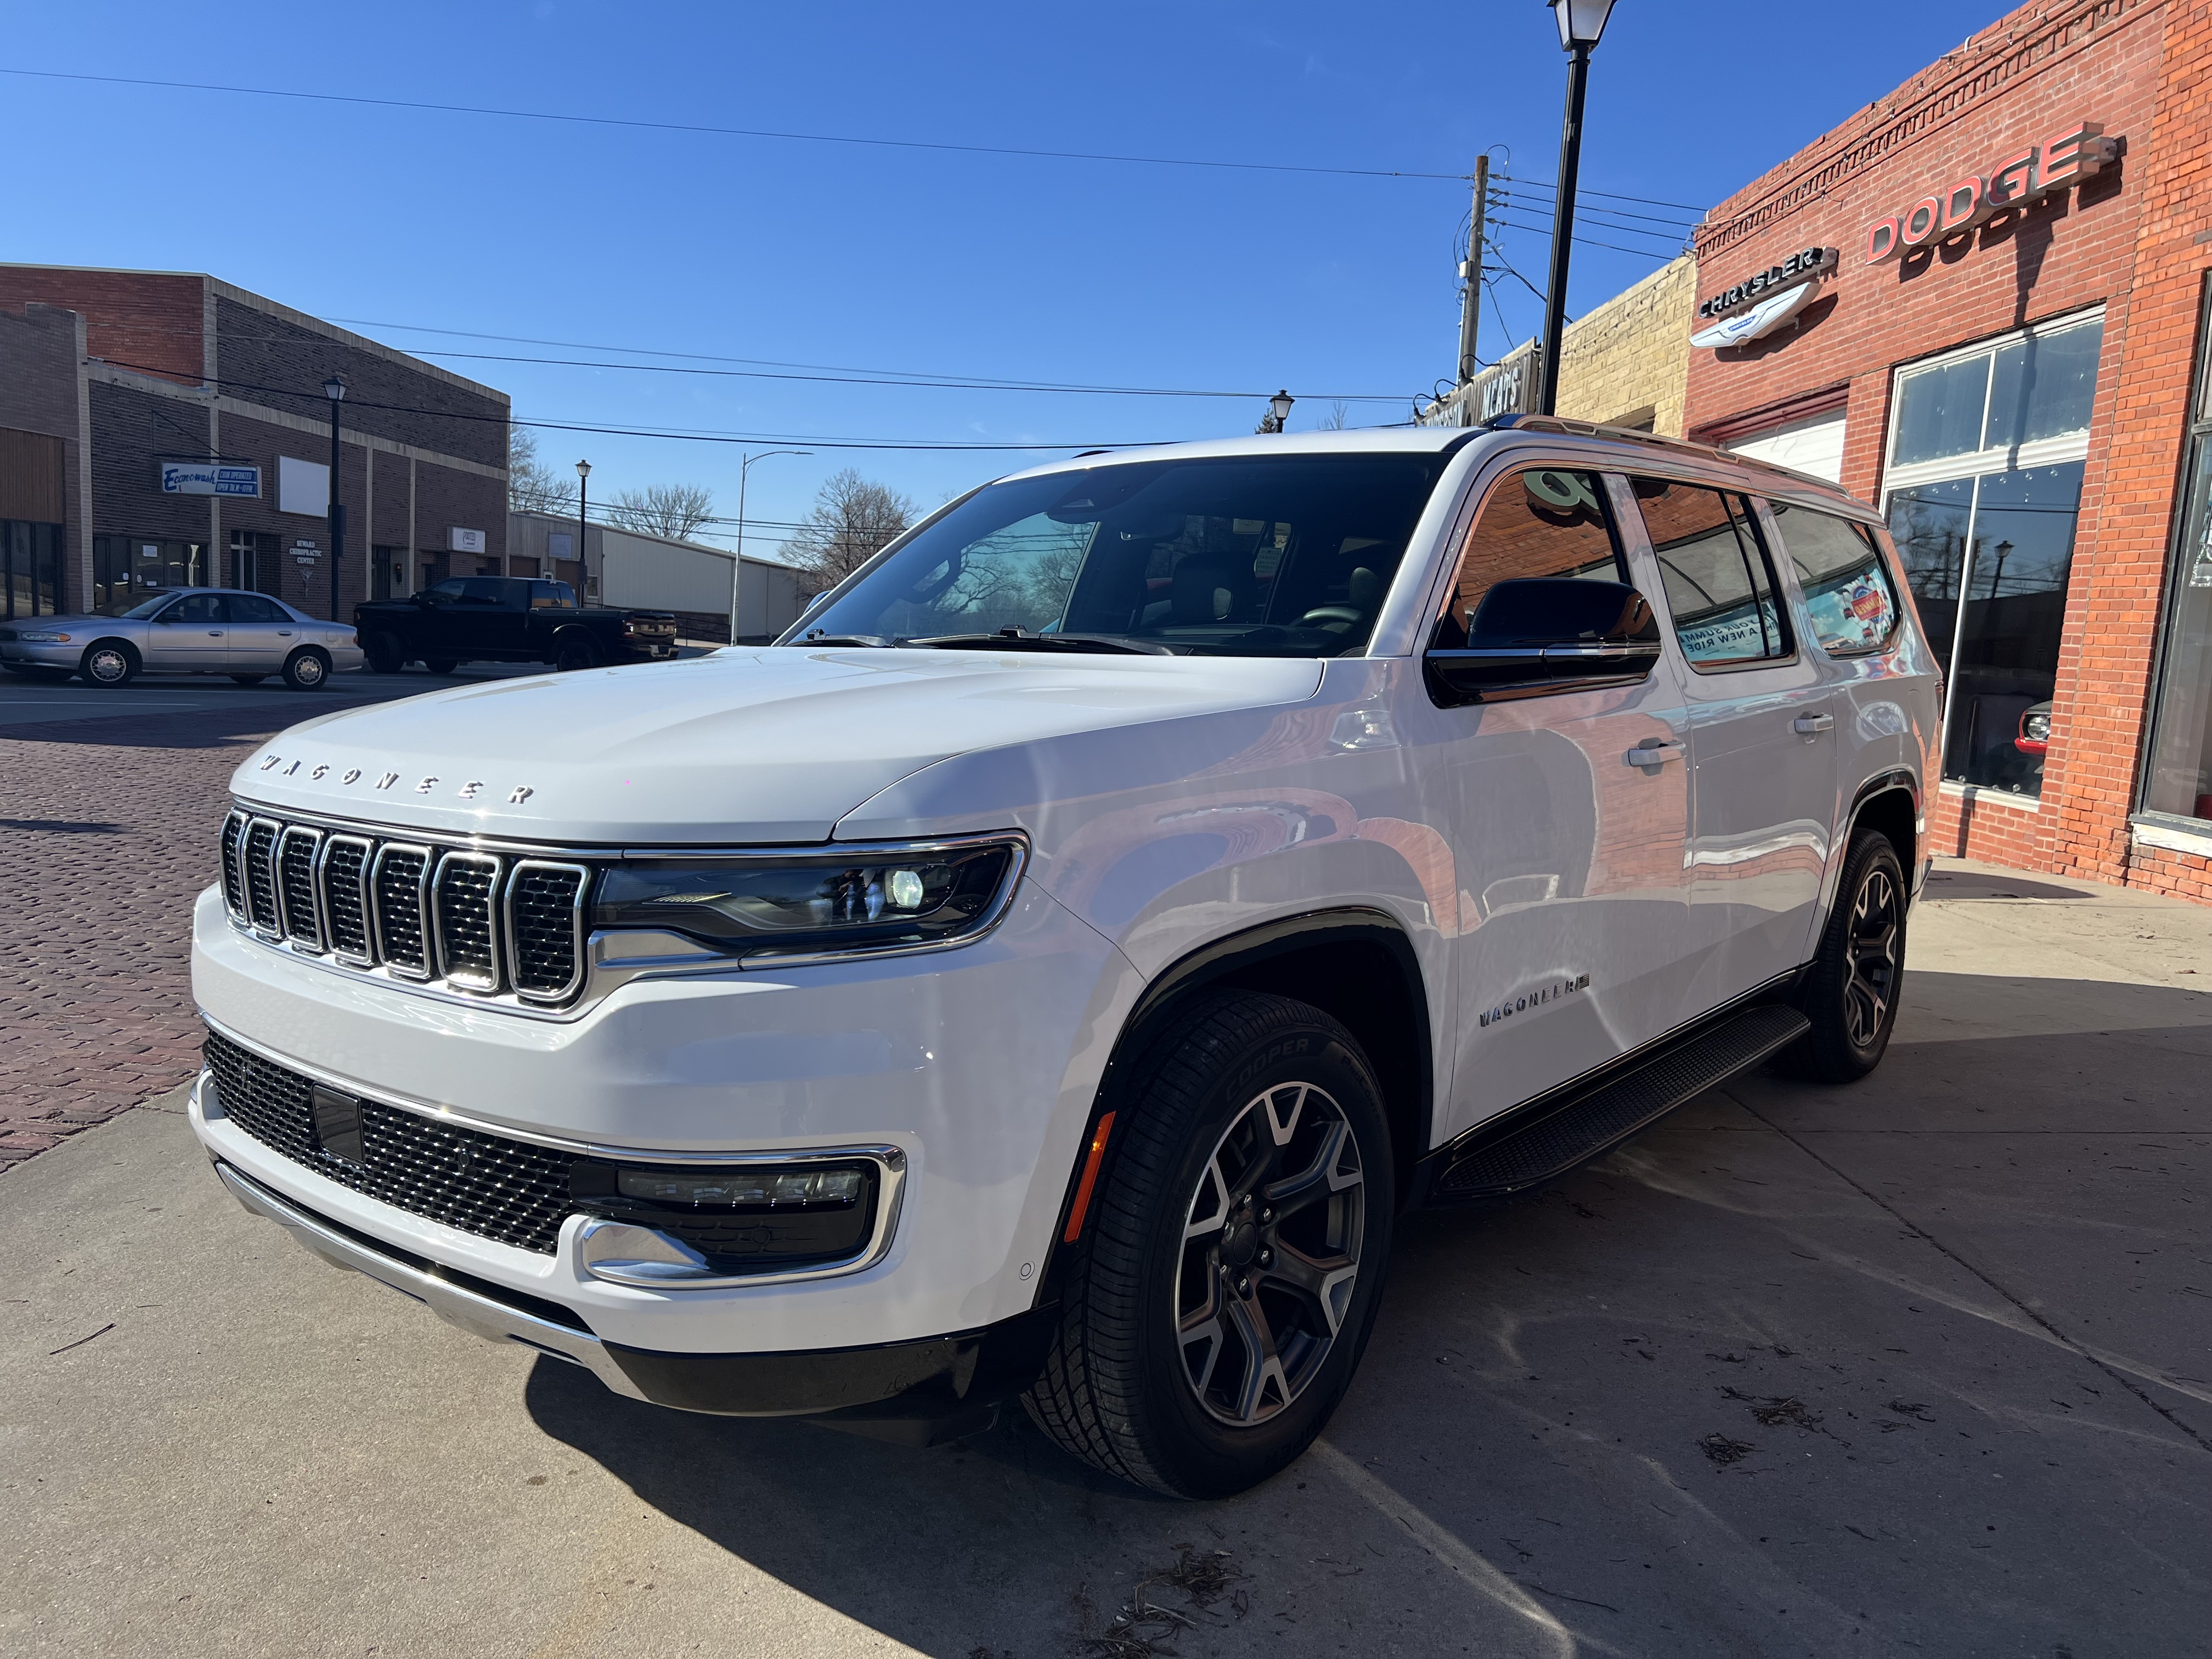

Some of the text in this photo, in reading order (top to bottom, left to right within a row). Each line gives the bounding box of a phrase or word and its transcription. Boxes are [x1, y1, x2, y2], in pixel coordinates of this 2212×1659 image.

[1865, 121, 2085, 266] DODGE
[1699, 247, 1817, 319] CHRYSLER
[1481, 366, 1520, 422] MEATS
[290, 548, 322, 557] CHIROPRACTIC
[297, 540, 315, 548] SEWARD
[259, 755, 534, 804] WAGONEER
[1480, 979, 1575, 1028] WAGONEER
[1225, 1038, 1309, 1103] COOPER
